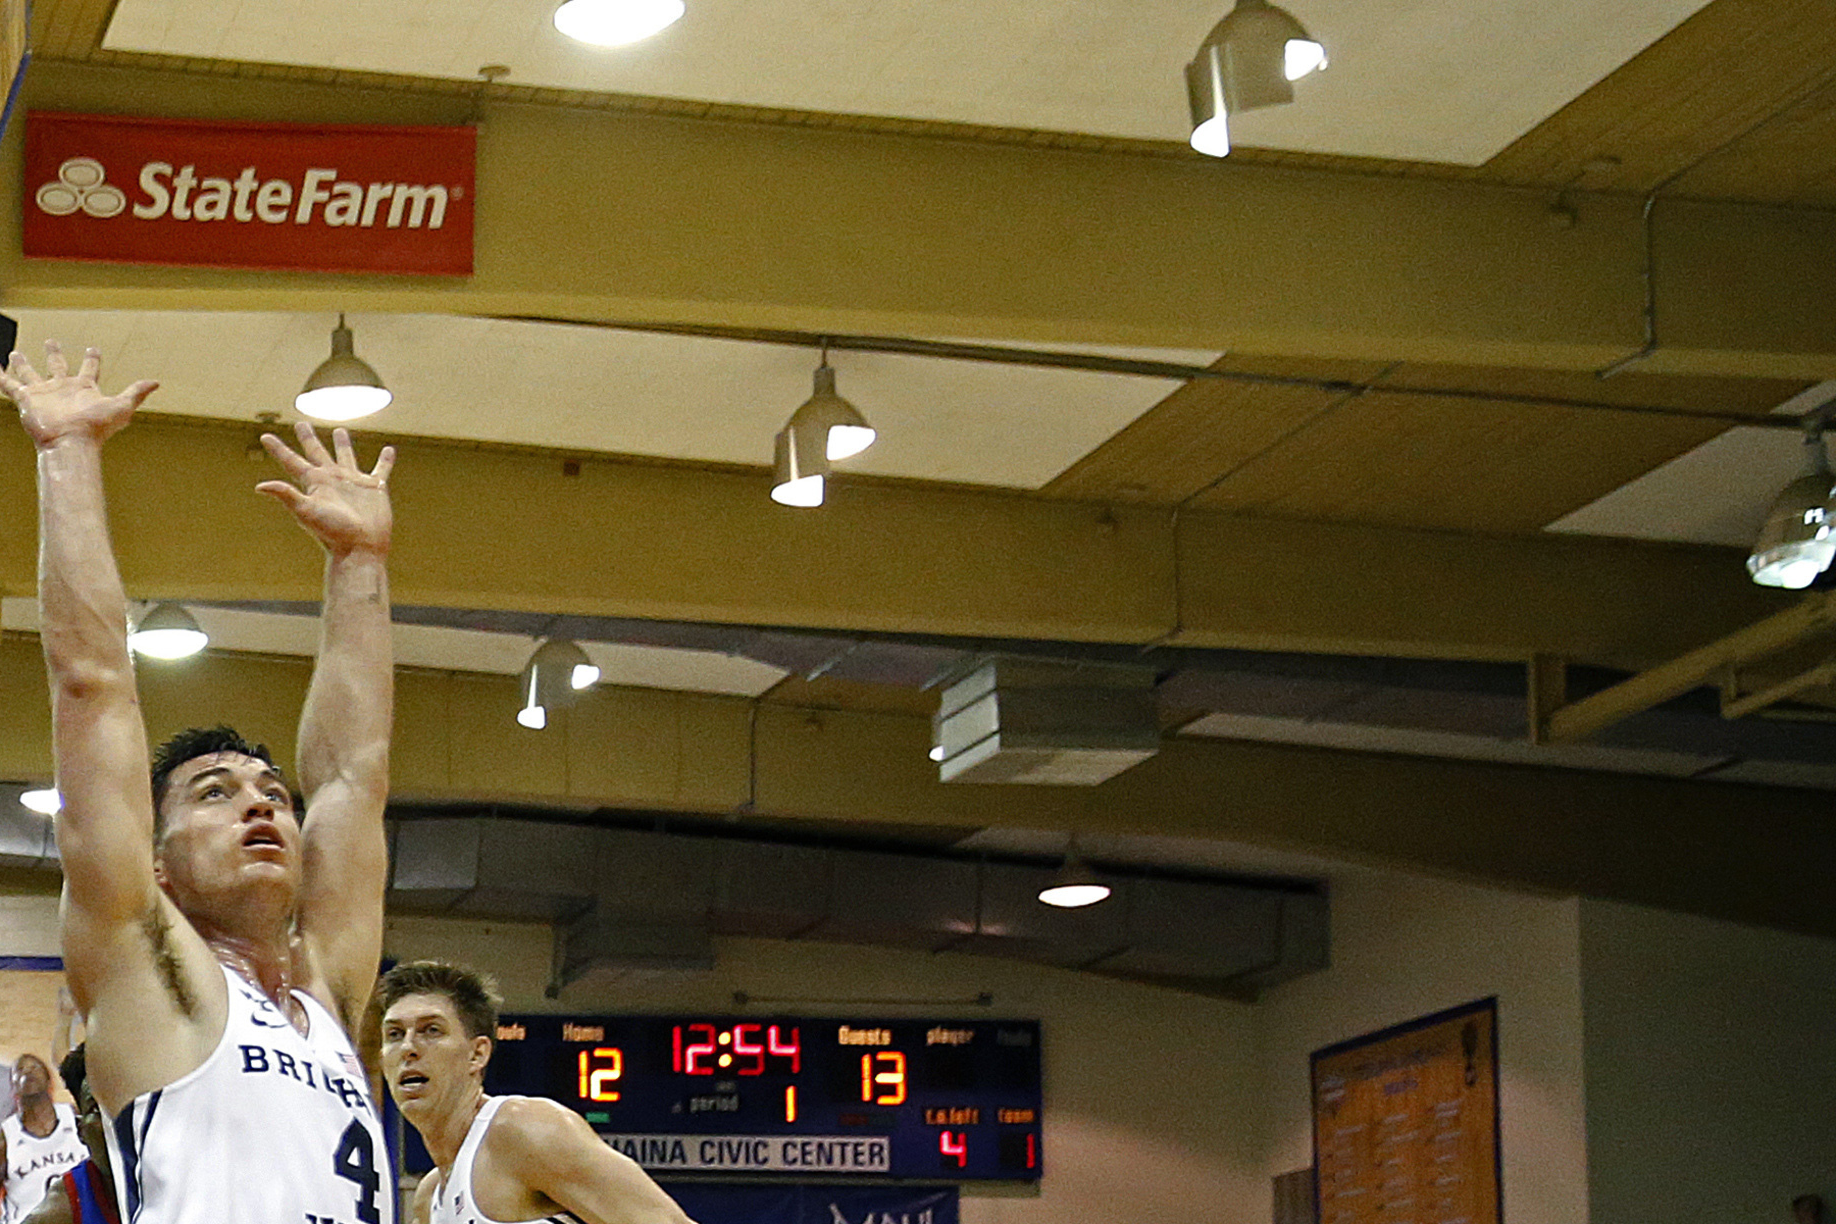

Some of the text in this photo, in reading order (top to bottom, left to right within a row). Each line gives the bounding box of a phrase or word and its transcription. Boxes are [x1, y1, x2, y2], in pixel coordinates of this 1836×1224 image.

[671, 1023, 801, 1076] 12:54
[578, 1048, 623, 1102] 12
[861, 1051, 907, 1106] 13
[785, 1085, 798, 1123] 1
[699, 1139, 770, 1166] CIVIC
[781, 1141, 884, 1167] CENTER
[939, 1130, 967, 1168] 4
[1025, 1132, 1036, 1169] 1
